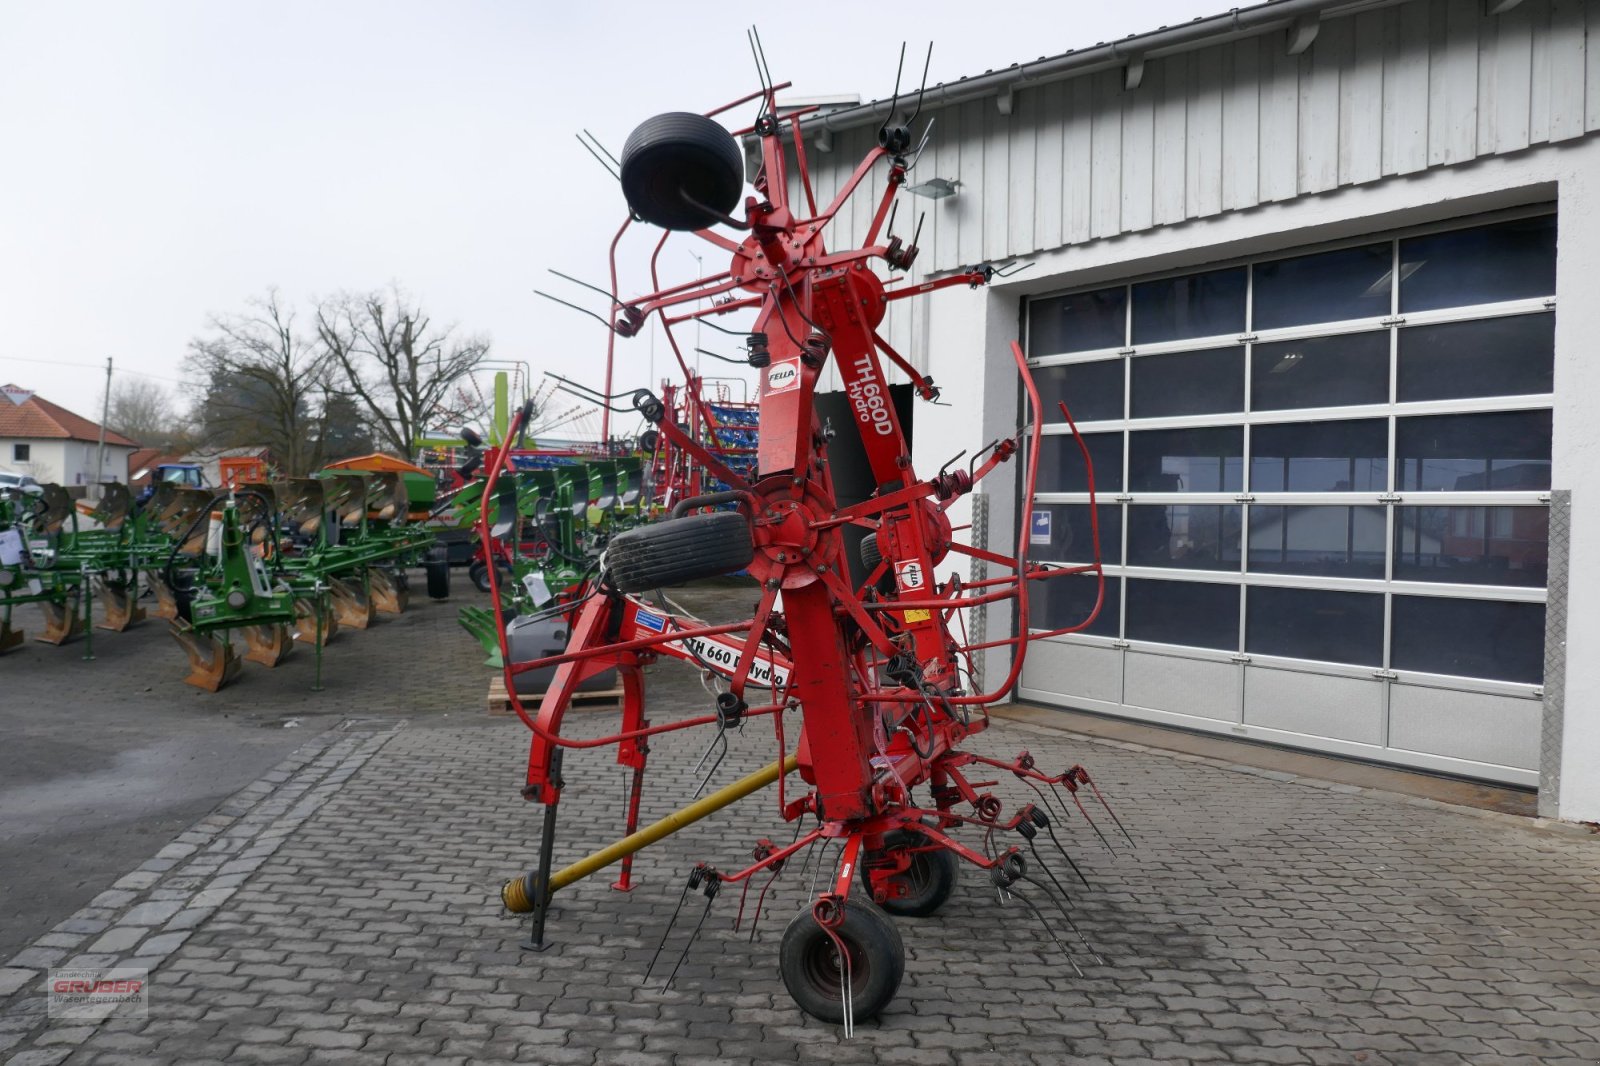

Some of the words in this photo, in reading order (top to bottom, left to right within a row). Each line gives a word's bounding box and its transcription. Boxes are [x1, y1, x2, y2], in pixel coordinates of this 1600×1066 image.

[769, 369, 794, 382] FELLA
[848, 381, 870, 422] Hydro
[908, 564, 919, 587] FELLA
[690, 638, 706, 655] TH
[707, 646, 732, 664] 660
